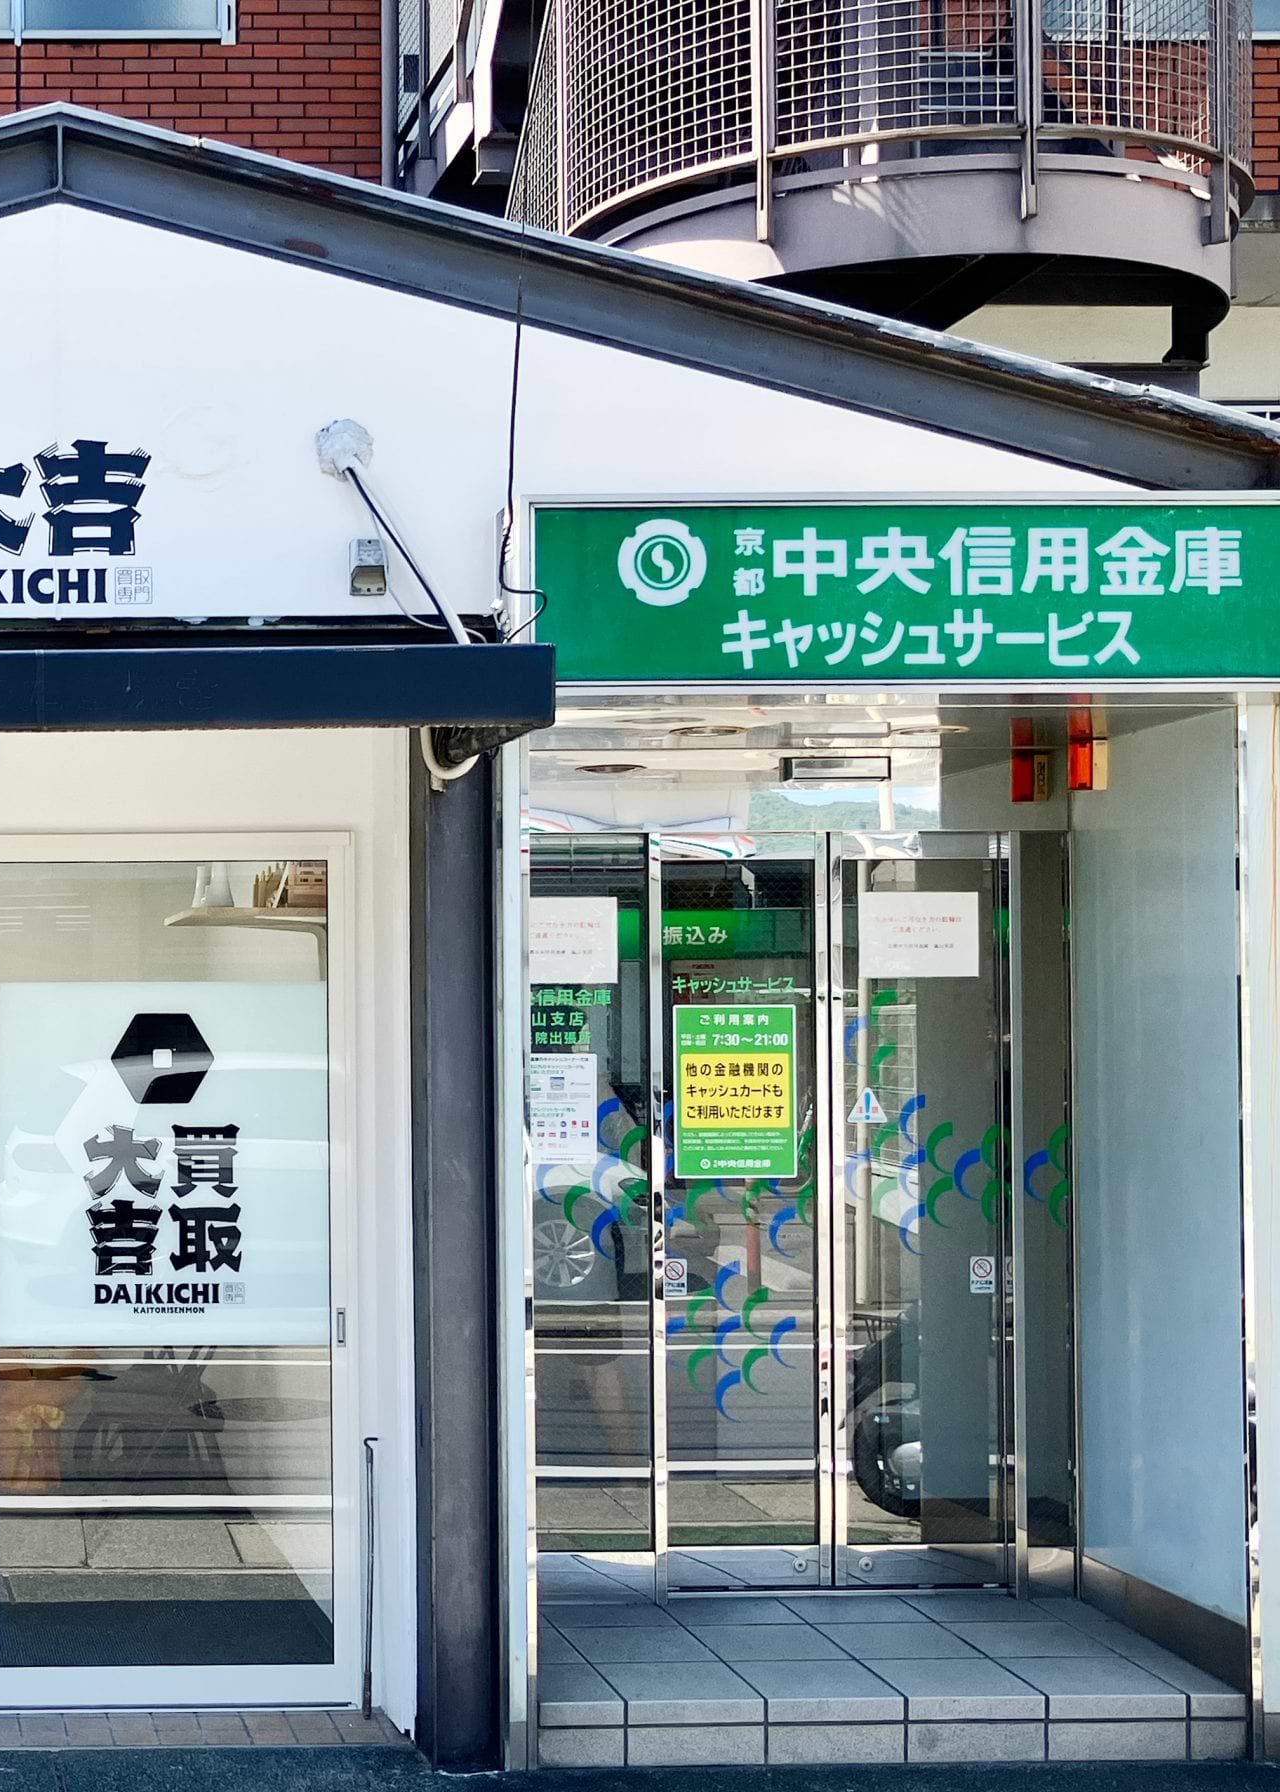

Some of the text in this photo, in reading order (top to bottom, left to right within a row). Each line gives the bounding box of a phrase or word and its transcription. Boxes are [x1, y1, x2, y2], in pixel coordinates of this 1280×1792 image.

[771, 525, 1243, 597] 中央信用金庫
[721, 609, 1141, 670] キャッシュサービス
[663, 926, 728, 945] 振込み
[672, 976, 796, 995] キャッシュサービス
[530, 989, 612, 1006] 信用金庫
[699, 1013, 769, 1026] ご利用案内
[530, 1031, 592, 1045] 院出張所
[685, 1062, 784, 1078] 他の金融機関の
[685, 1083, 784, 1098] キャッシュカードも
[686, 1105, 785, 1120] ご利用いただけます
[94, 1283, 220, 1304] DAIKICHI
[133, 1306, 205, 1314] KAITORISENMON
